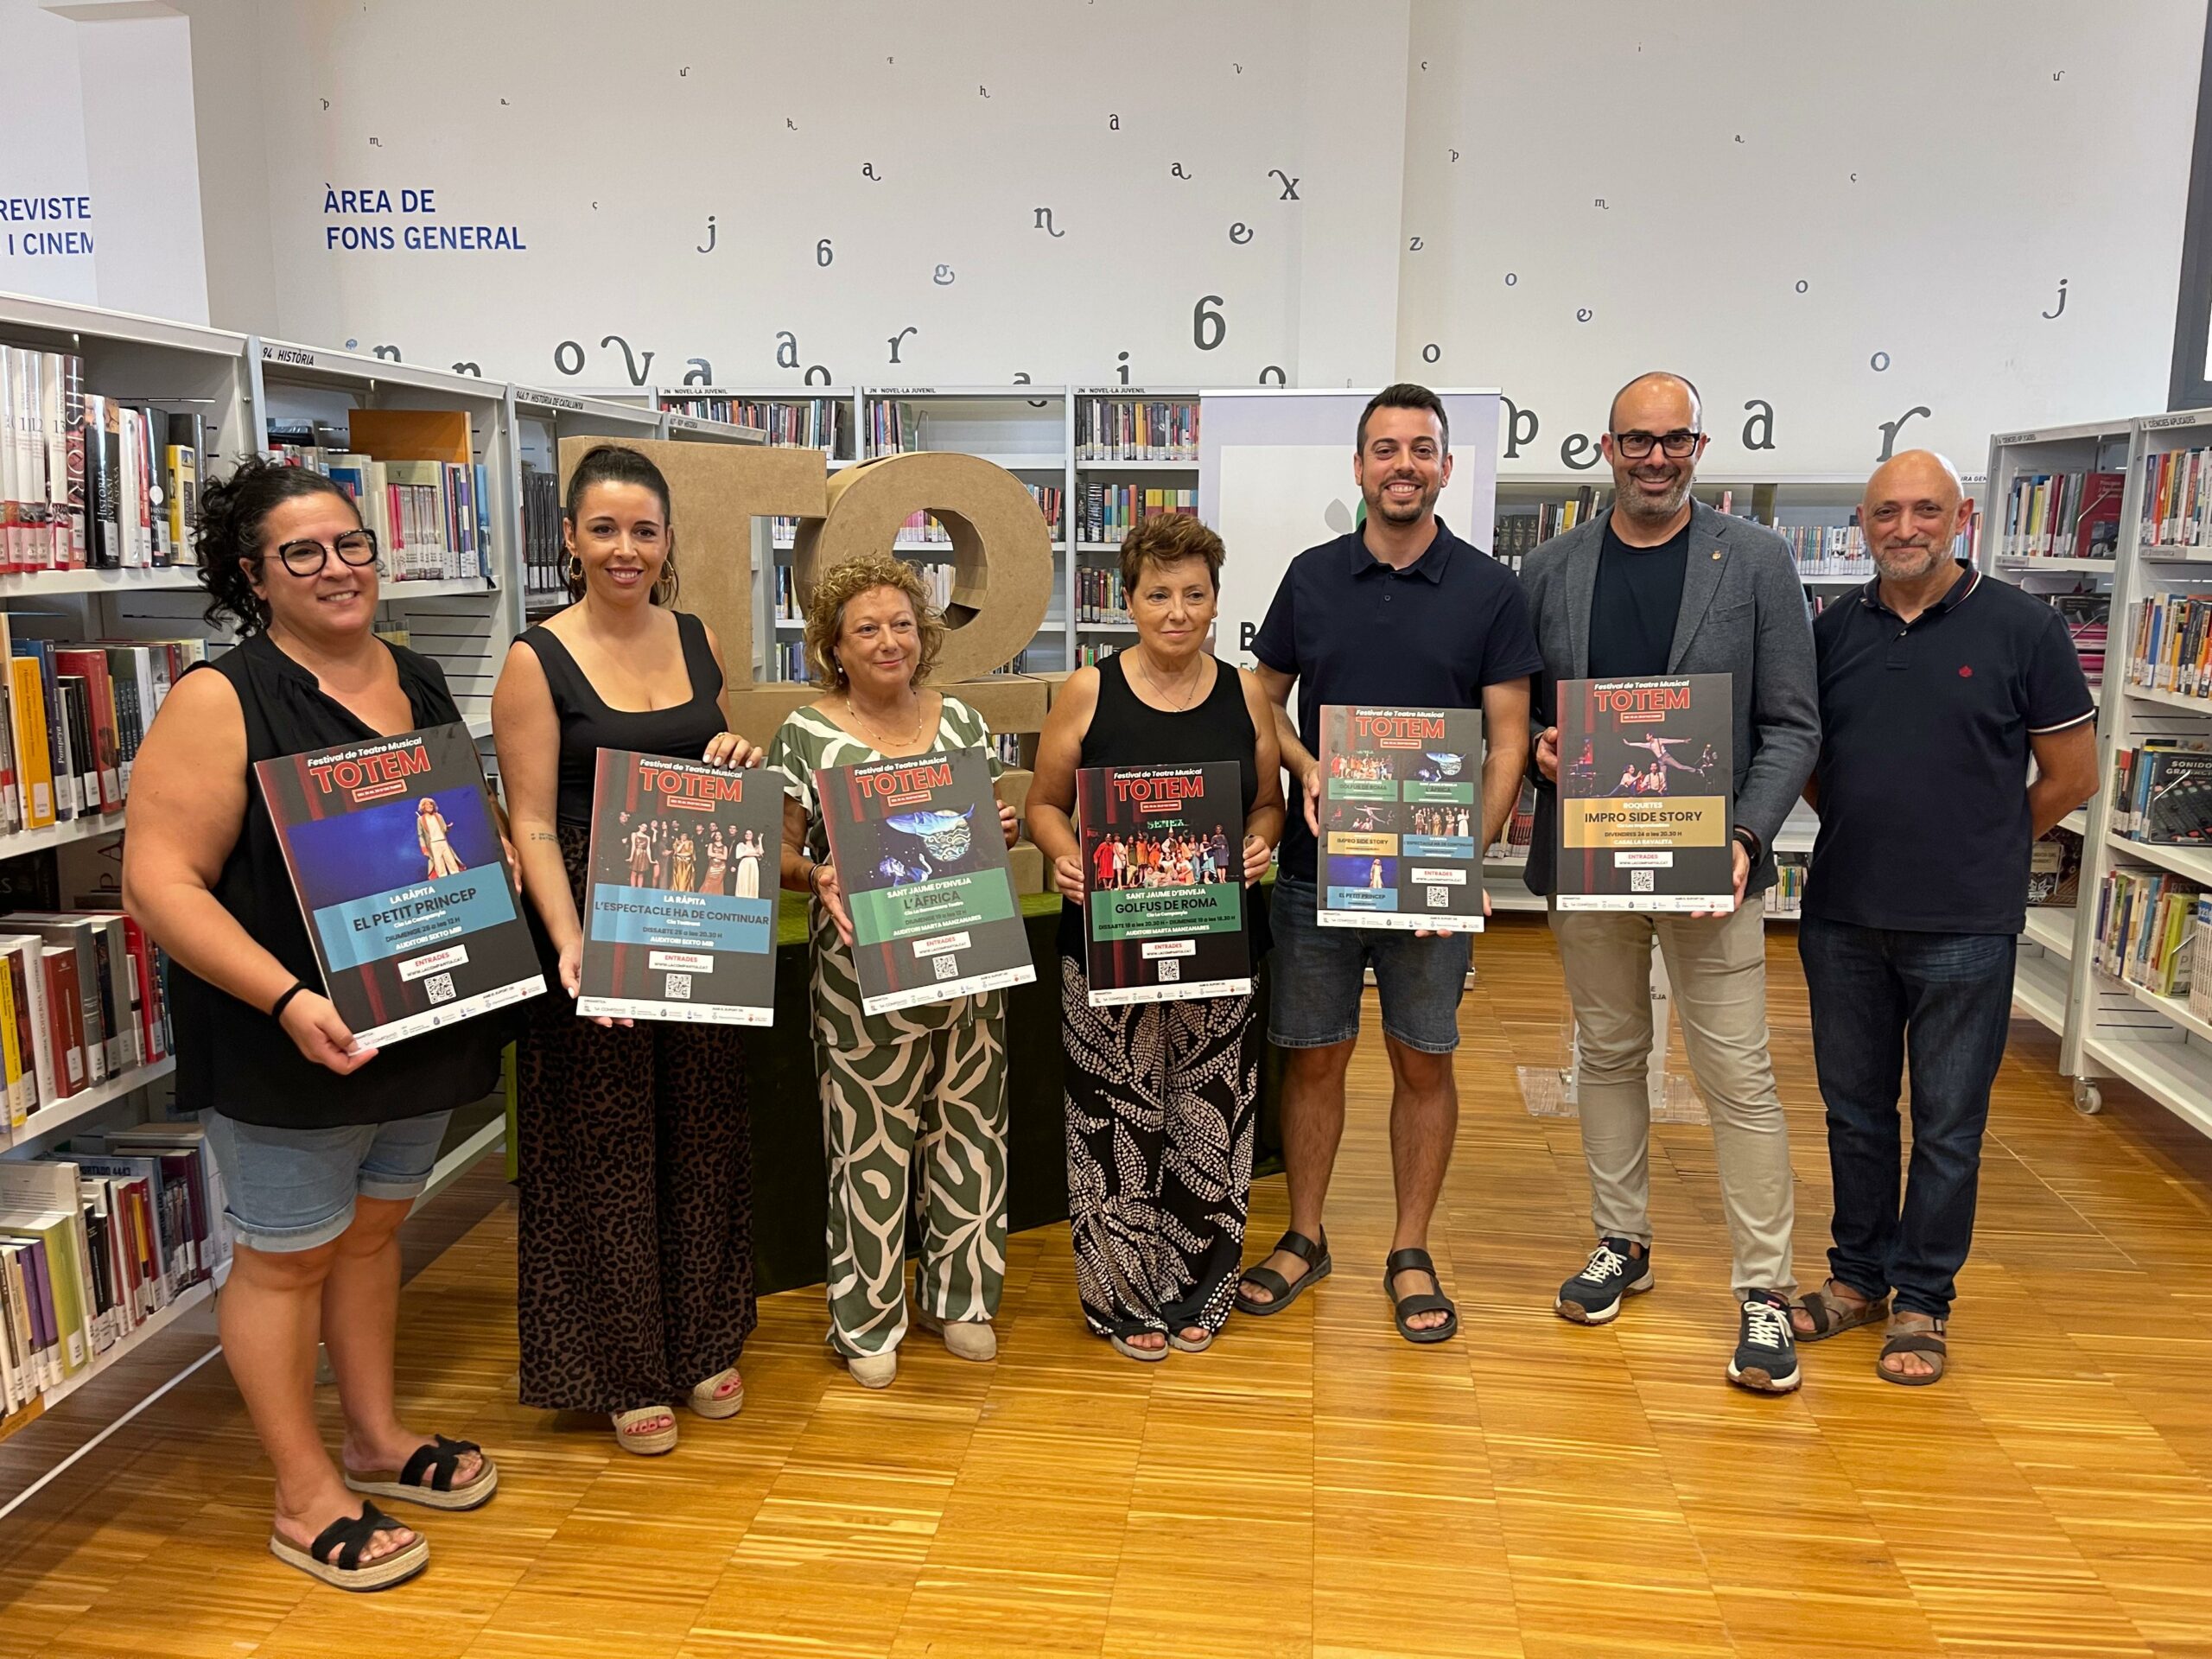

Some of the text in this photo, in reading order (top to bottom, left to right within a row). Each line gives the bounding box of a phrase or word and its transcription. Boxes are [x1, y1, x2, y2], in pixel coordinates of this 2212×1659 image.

[1109, 114, 1120, 130] a
[862, 162, 881, 181] a
[1172, 162, 1192, 180] a
[1268, 170, 1300, 200] x
[324, 182, 436, 213] ÀREA DE
[697, 216, 716, 254] j
[1034, 208, 1065, 238] n
[1230, 223, 1253, 245] e
[9, 233, 14, 255] I
[327, 226, 527, 251] FONS GENERAL
[817, 239, 834, 267] 6
[1505, 273, 1518, 287] o
[1796, 280, 1808, 294] o
[2042, 279, 2068, 320] j
[1194, 296, 1225, 351] 6
[1577, 308, 1593, 323] e
[263, 346, 314, 366] 94 HISTÒRIA
[776, 331, 800, 368] a
[887, 327, 918, 363] r
[1422, 344, 1441, 364] o
[555, 341, 585, 375] o
[1871, 352, 1891, 372] o
[1500, 397, 1539, 458] p
[1742, 400, 1777, 451] a
[1878, 406, 1932, 463] r
[1561, 434, 1602, 470] e
[1594, 687, 1689, 712] TOTEM
[1356, 715, 1444, 739] TOTEM
[306, 737, 423, 767] Festival de Teatre Musical
[309, 745, 431, 795] TOTEM
[639, 758, 741, 779] Festival de Teatre Musical
[854, 755, 947, 776] Festival de Teatre Musical
[2171, 760, 2212, 769] SONIDO
[638, 766, 742, 803] TOTEM
[855, 763, 952, 798] TOTEM
[1114, 775, 1204, 802] TOTEM
[1585, 811, 1702, 822] IMPRO SIDE STORY
[389, 883, 435, 904] LA RÀPITA
[676, 894, 706, 906] RÀPITA
[887, 888, 908, 898] SANT
[907, 883, 935, 894] JAUME
[353, 887, 478, 931] EL PETIT PRINCEP
[673, 908, 689, 918] HA
[691, 910, 704, 918] DE
[707, 911, 769, 925] CONTINUAR
[1116, 897, 1217, 913] GOLFUS DE ROMA
[926, 936, 956, 946] ENTRADES
[414, 951, 450, 966] ENTRADES
